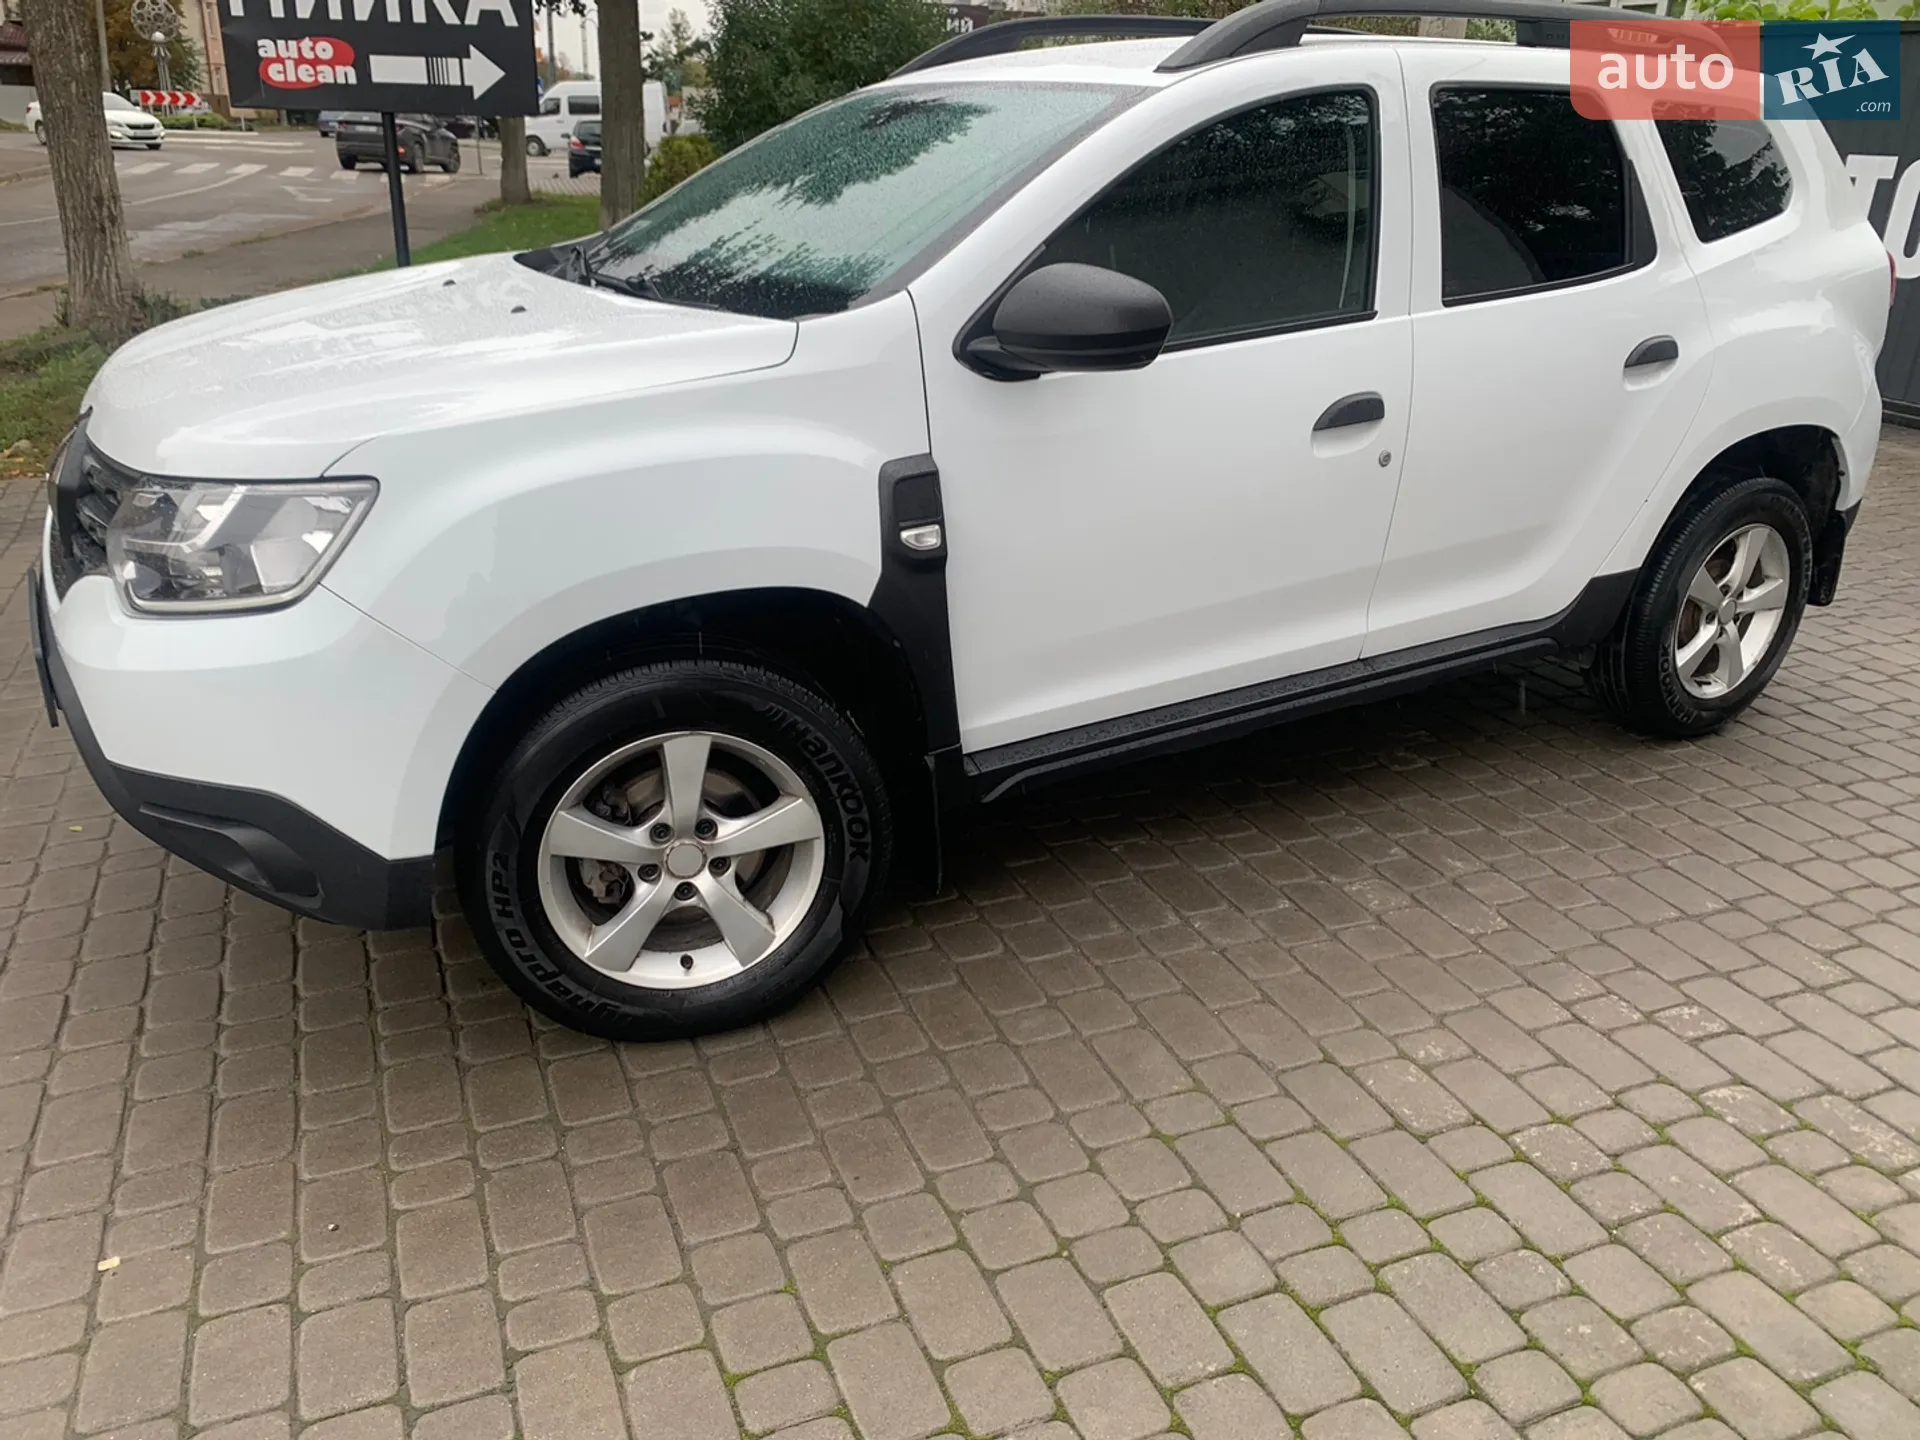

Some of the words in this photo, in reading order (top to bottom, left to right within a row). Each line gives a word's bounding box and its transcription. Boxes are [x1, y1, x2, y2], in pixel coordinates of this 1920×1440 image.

[257, 36, 334, 60] auto
[267, 61, 358, 85] clean
[491, 851, 515, 919] HP2
